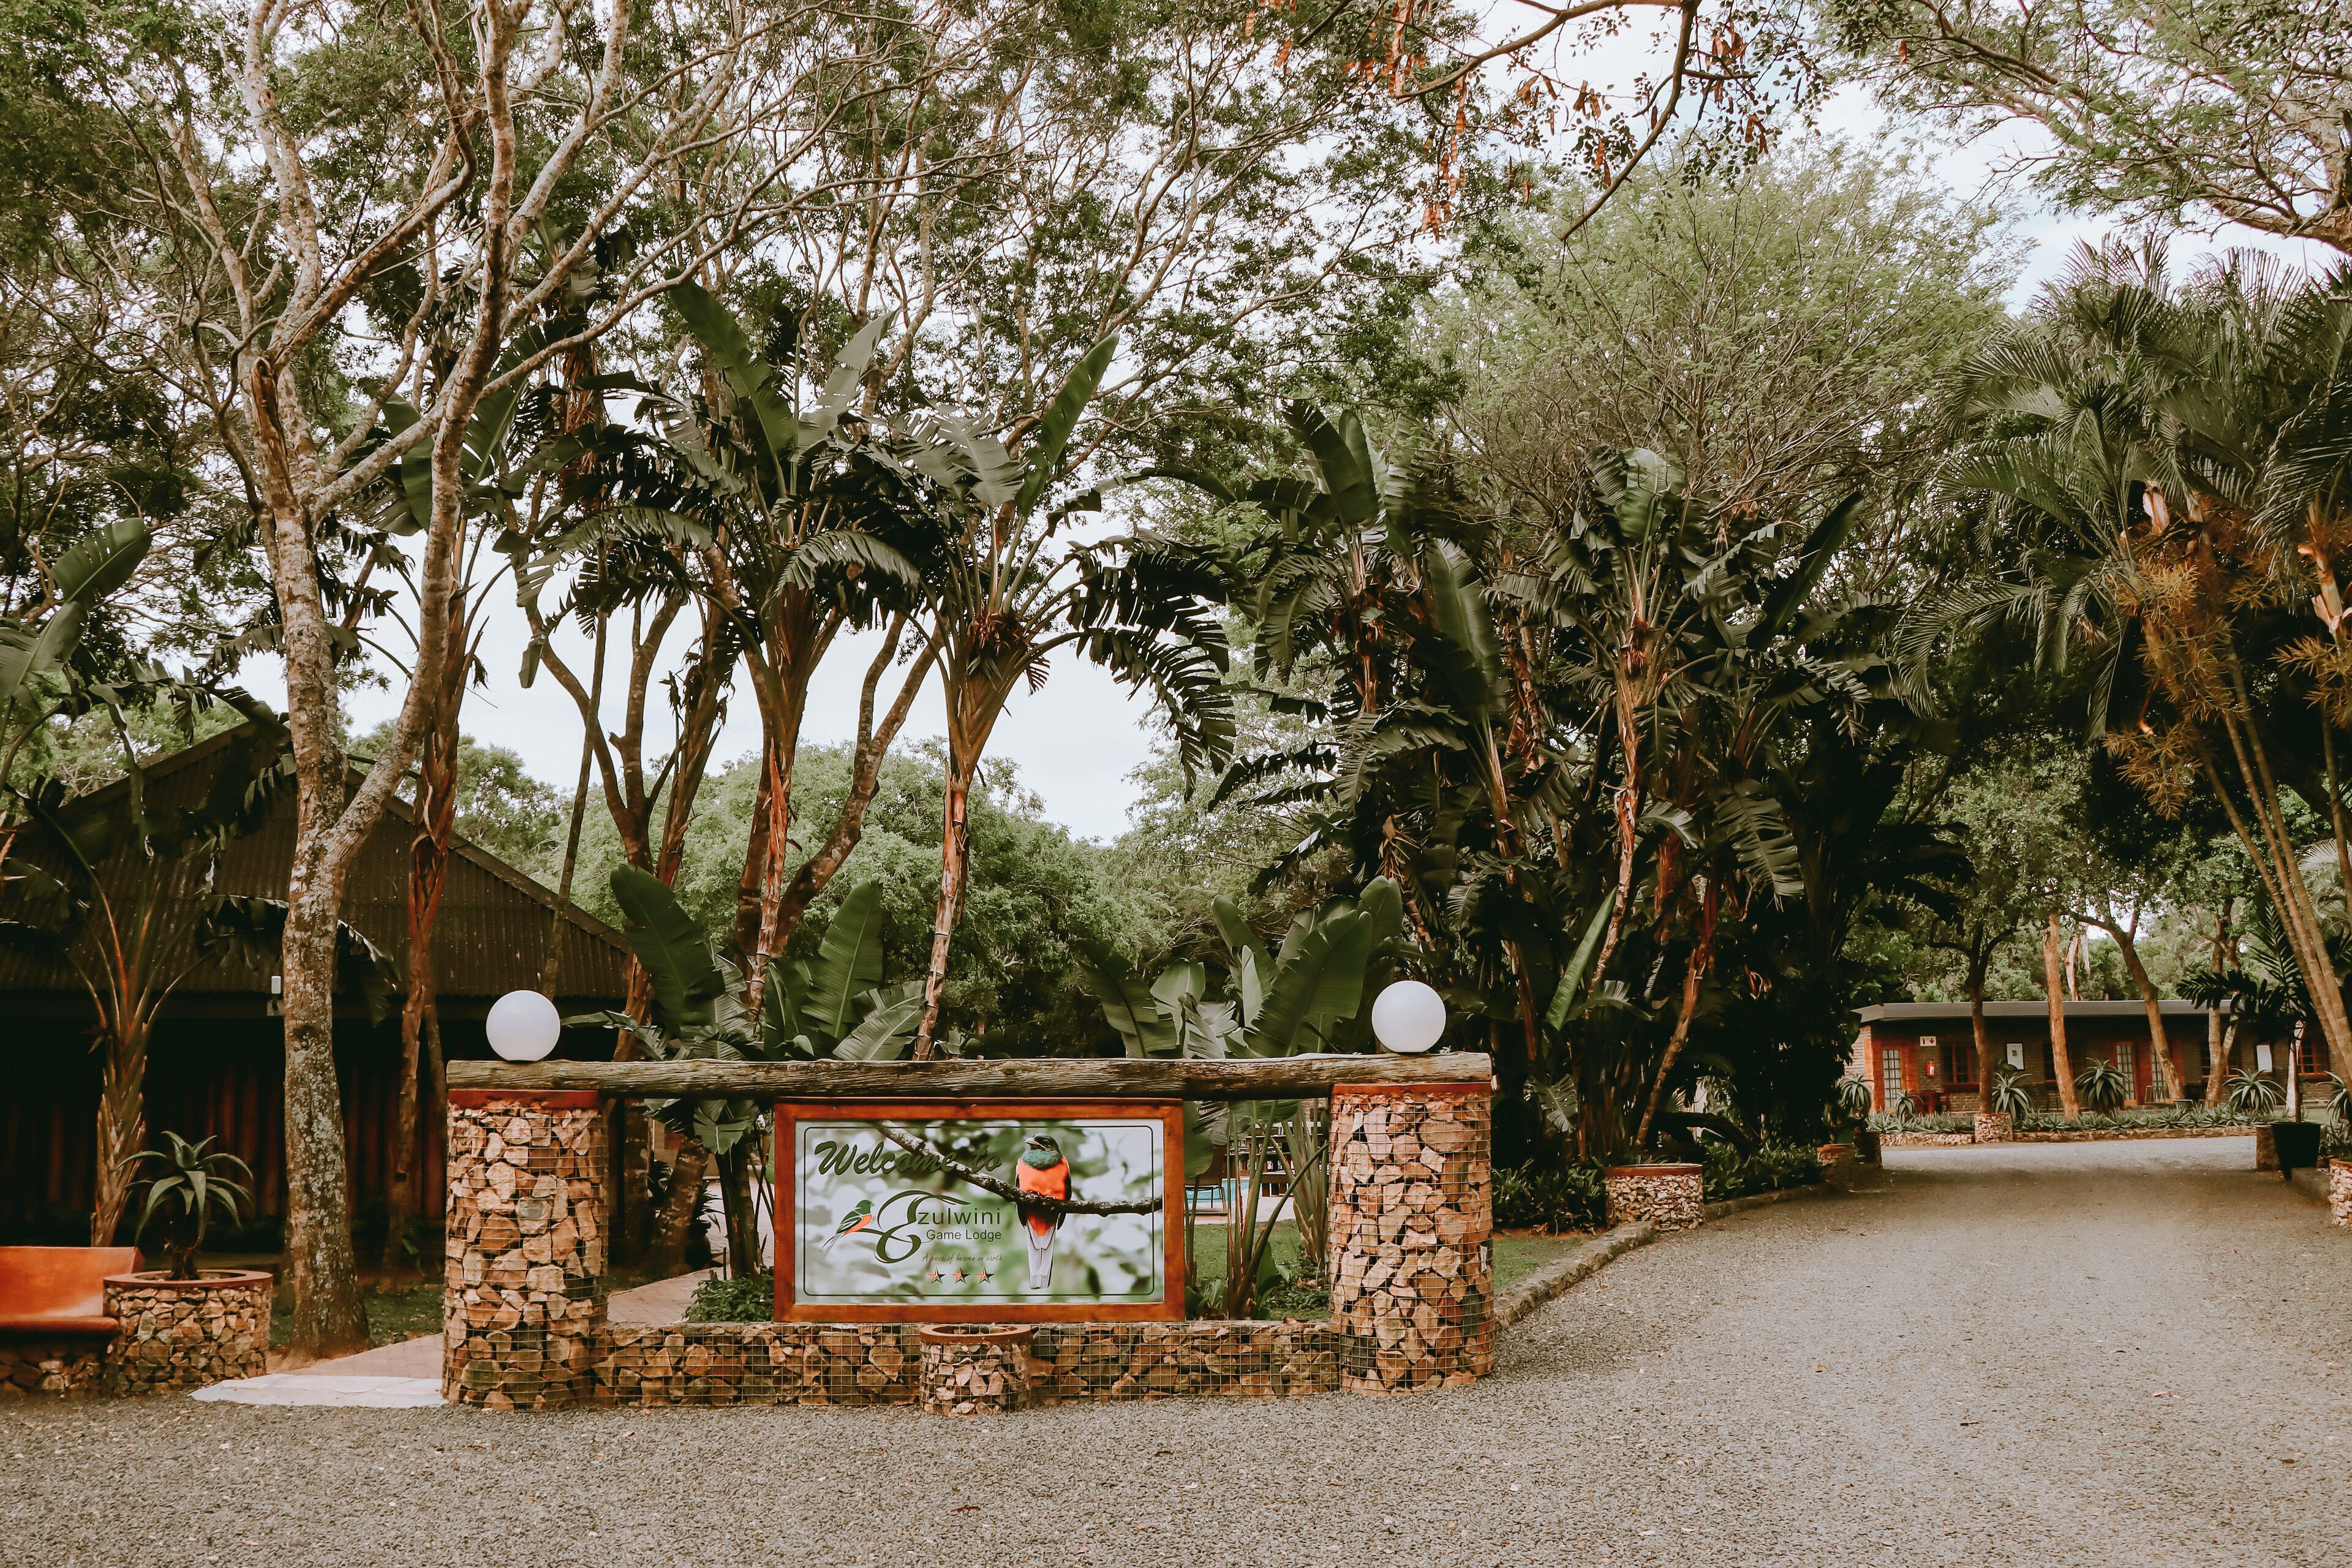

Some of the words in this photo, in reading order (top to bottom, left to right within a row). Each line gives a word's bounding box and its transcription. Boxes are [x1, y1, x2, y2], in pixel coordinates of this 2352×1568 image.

[814, 1140, 957, 1176] Welcome
[971, 1145, 1002, 1172] to
[876, 1190, 1002, 1264] Ezulwini
[926, 1229, 962, 1240] Game
[965, 1229, 1002, 1242] Lodge
[922, 1252, 929, 1262] A
[929, 1254, 944, 1265] piece
[946, 1253, 956, 1265] of
[956, 1253, 975, 1262] heaven
[986, 1253, 1003, 1262] earth
